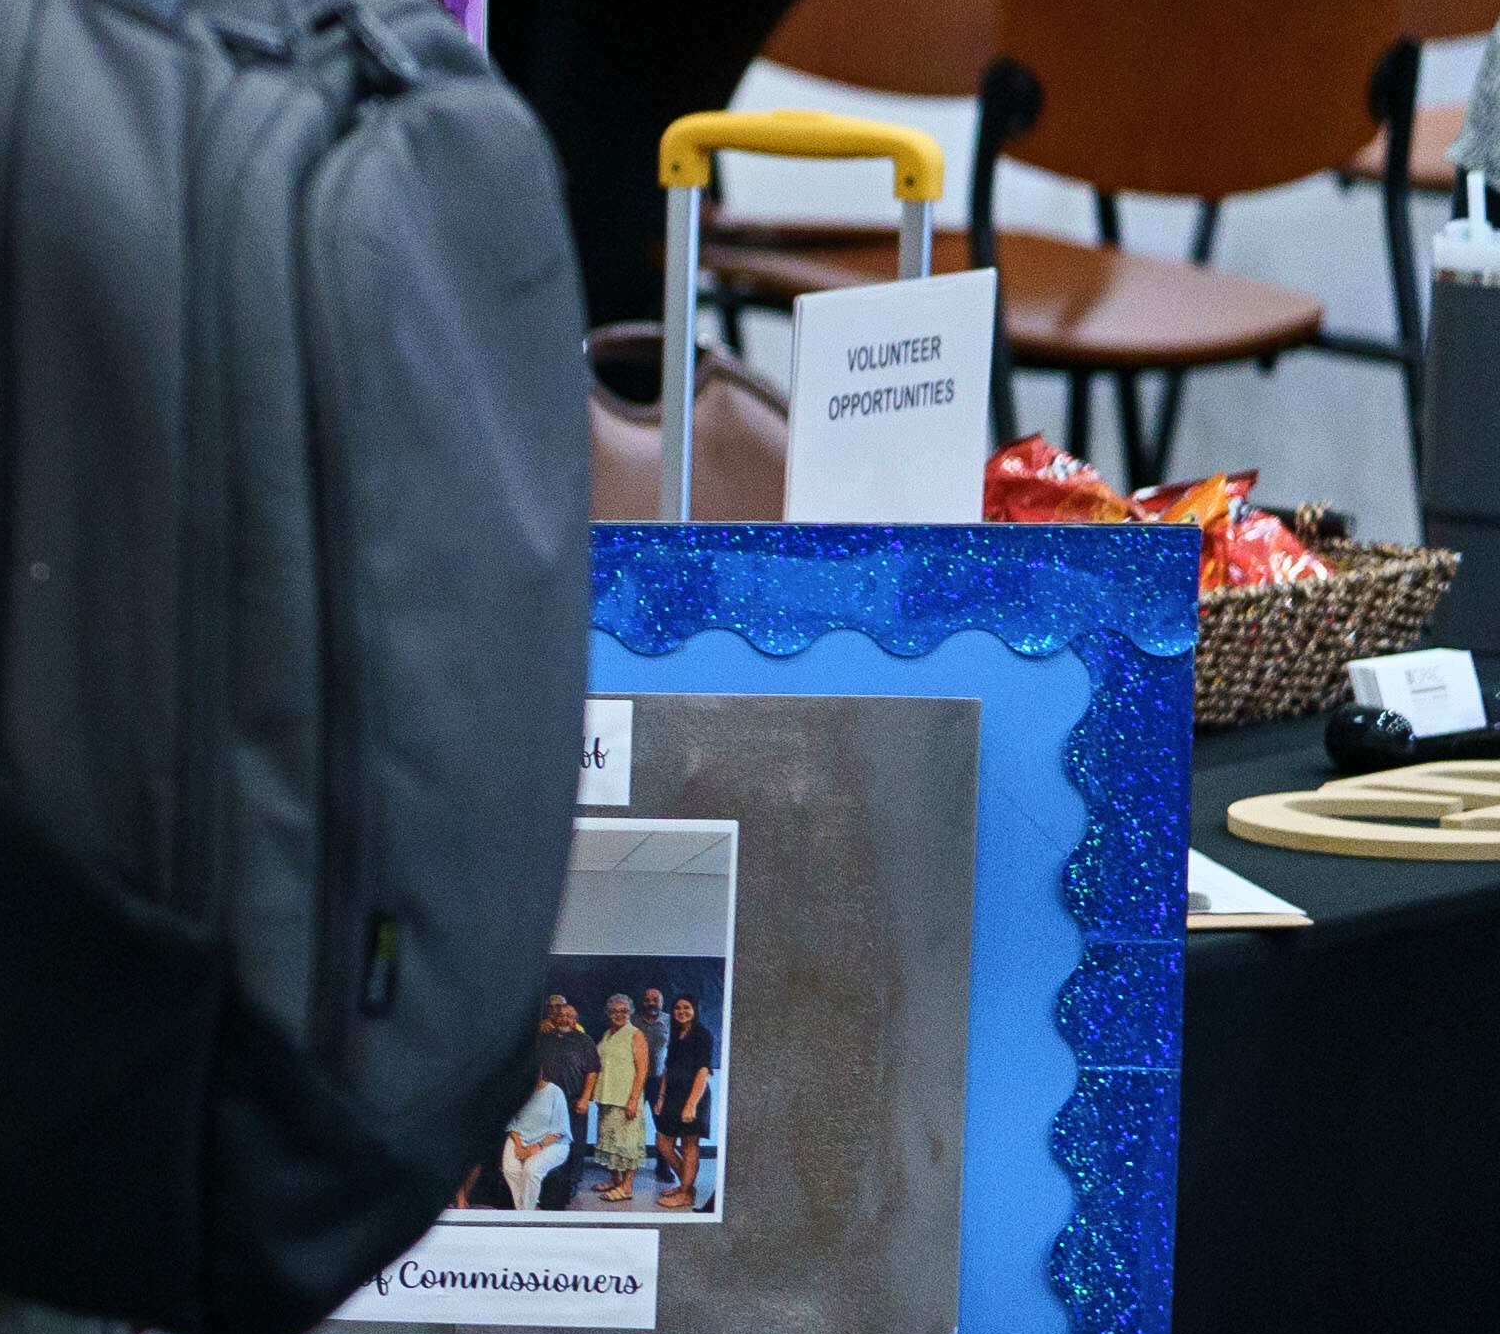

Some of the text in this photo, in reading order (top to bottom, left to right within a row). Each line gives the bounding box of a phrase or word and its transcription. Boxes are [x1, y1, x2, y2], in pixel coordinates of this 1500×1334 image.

[847, 335, 941, 372] VOLUNTEER
[828, 378, 955, 420] OPPORTUNITIES
[400, 1261, 642, 1294] Commissioners
